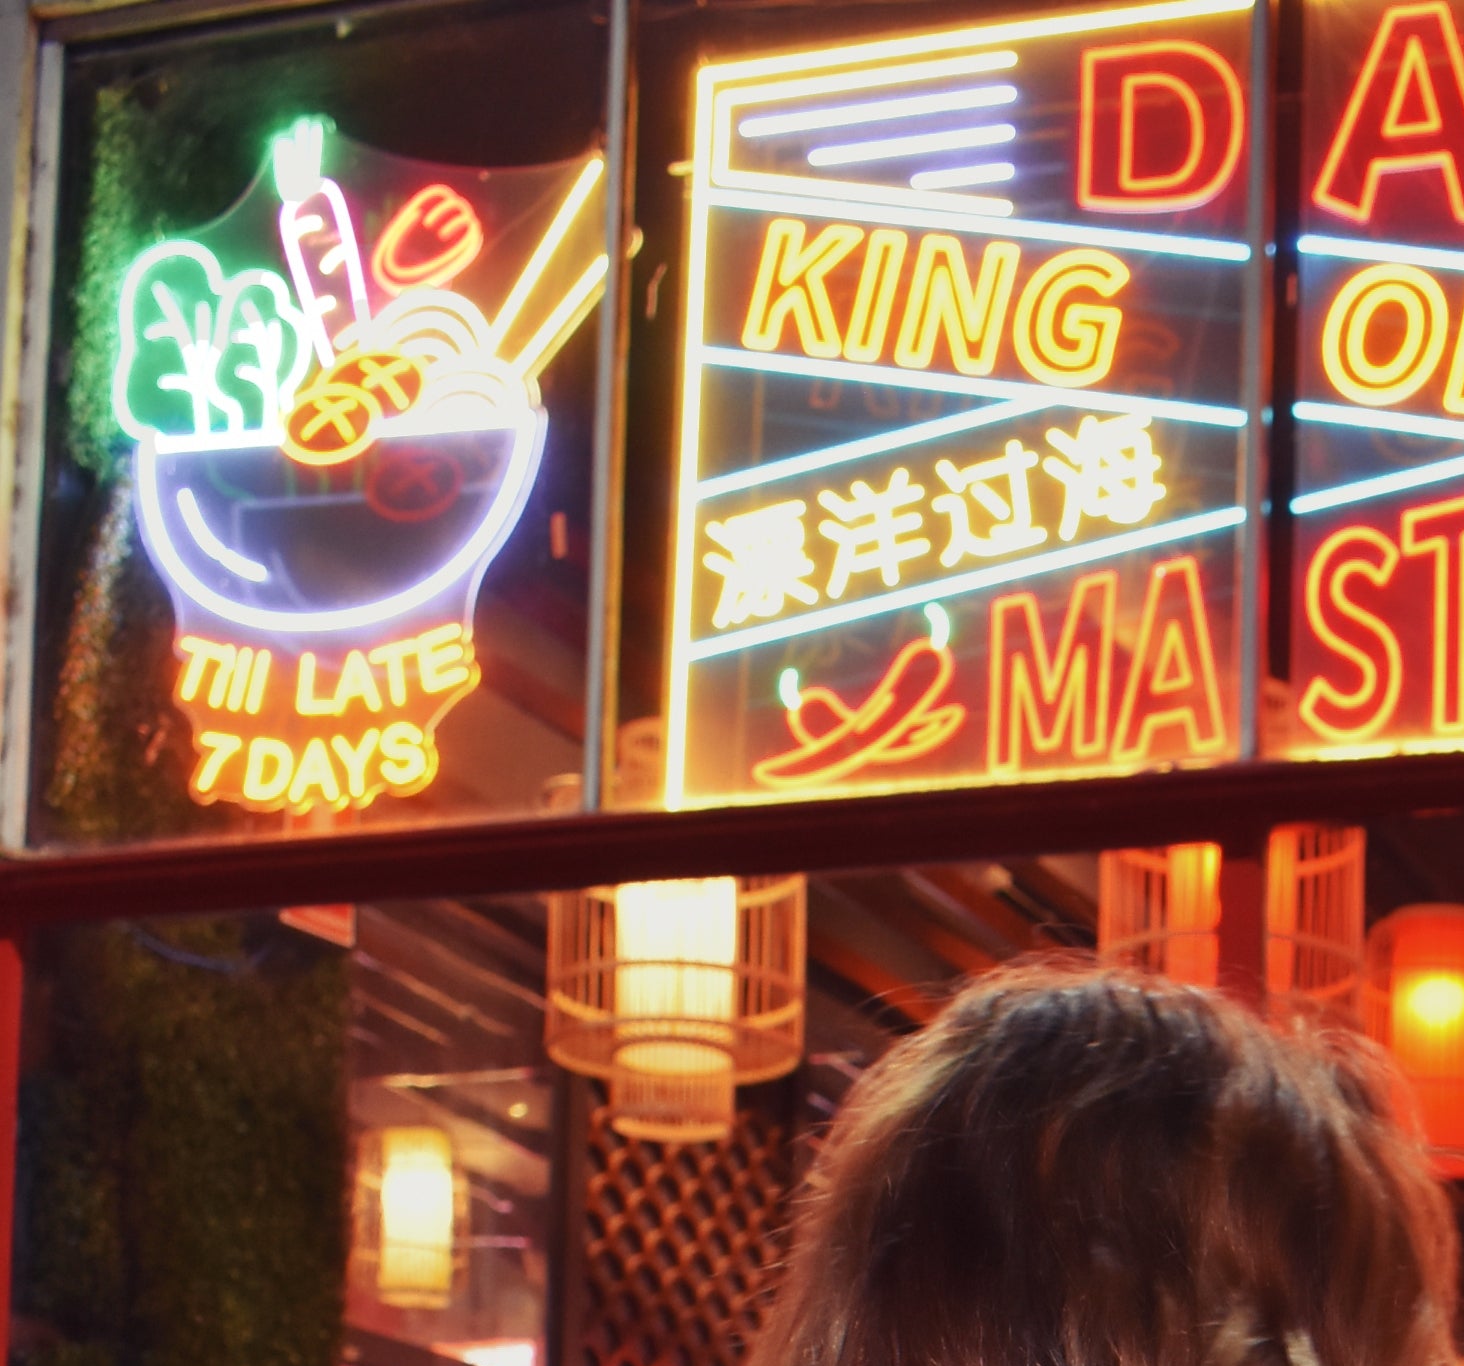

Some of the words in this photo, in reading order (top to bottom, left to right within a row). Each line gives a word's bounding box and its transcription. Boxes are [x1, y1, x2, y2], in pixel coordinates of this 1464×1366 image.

[740, 217, 1131, 389] KING
[294, 622, 470, 716] LATE
[242, 721, 428, 803] DAYS
